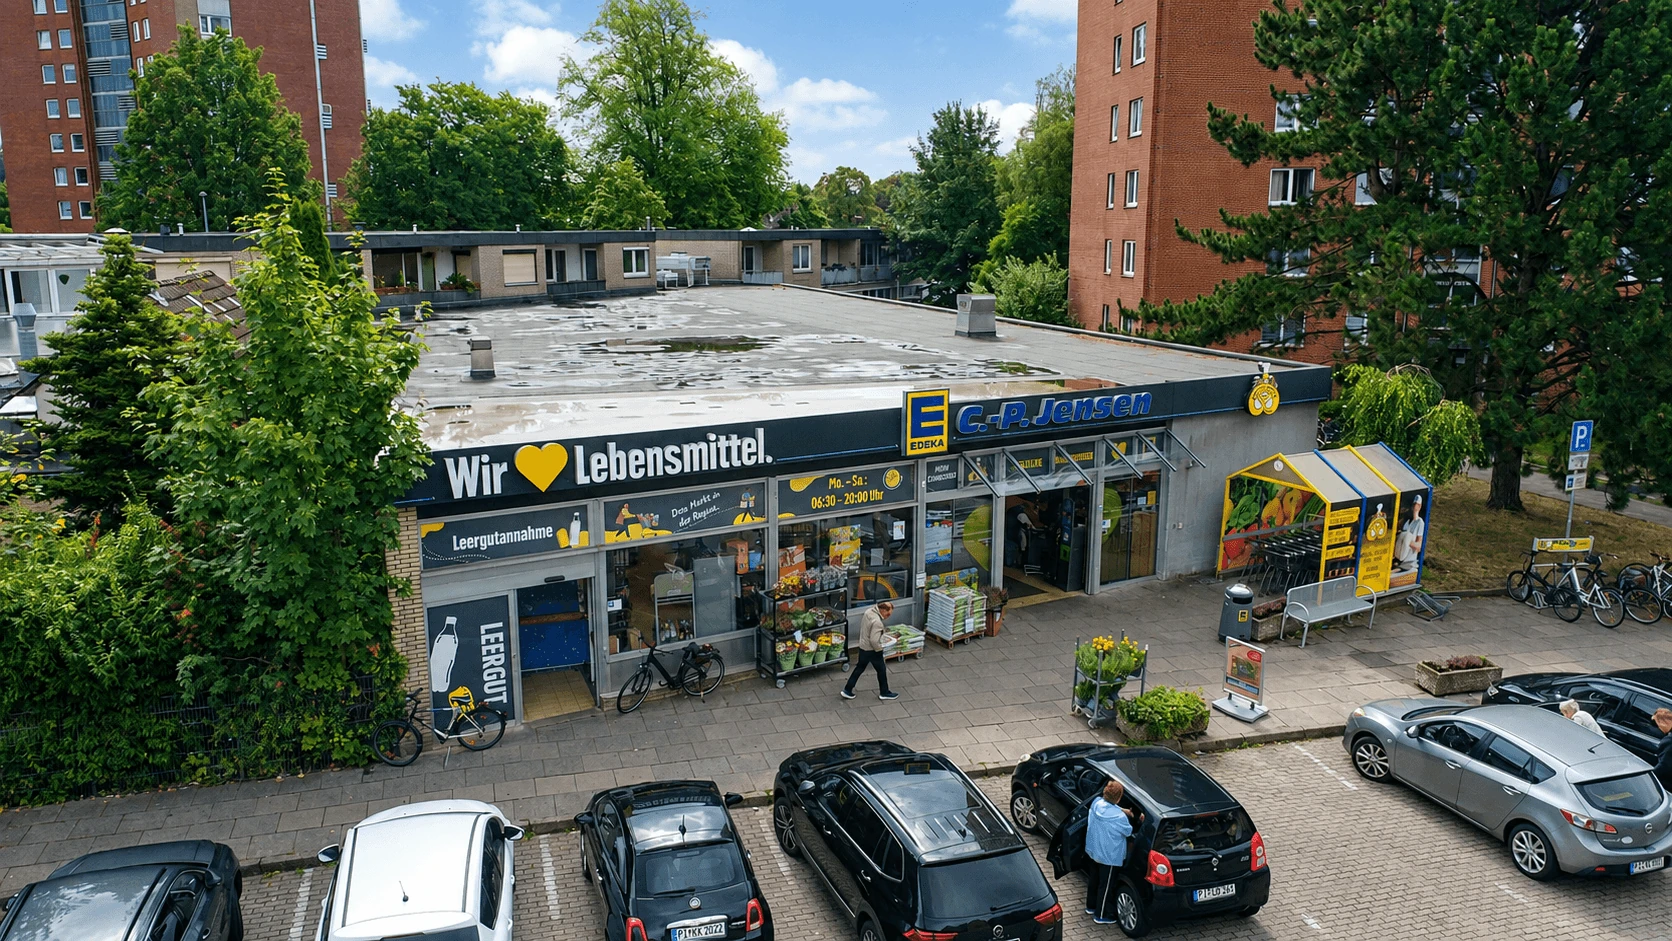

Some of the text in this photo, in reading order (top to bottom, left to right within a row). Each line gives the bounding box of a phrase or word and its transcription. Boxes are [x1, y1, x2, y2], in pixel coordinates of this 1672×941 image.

[955, 392, 1152, 434] C.-P. Jensen
[910, 438, 944, 451] EDEKA
[1575, 425, 1587, 448] P
[444, 428, 773, 499] Wir Lebensmittel.
[828, 477, 844, 489] Mo.
[811, 494, 836, 509] 06:30
[844, 490, 868, 505] 20:00
[869, 488, 884, 501] Uhr
[452, 525, 553, 551] Leergutannahme
[480, 622, 507, 703] LEERGUT
